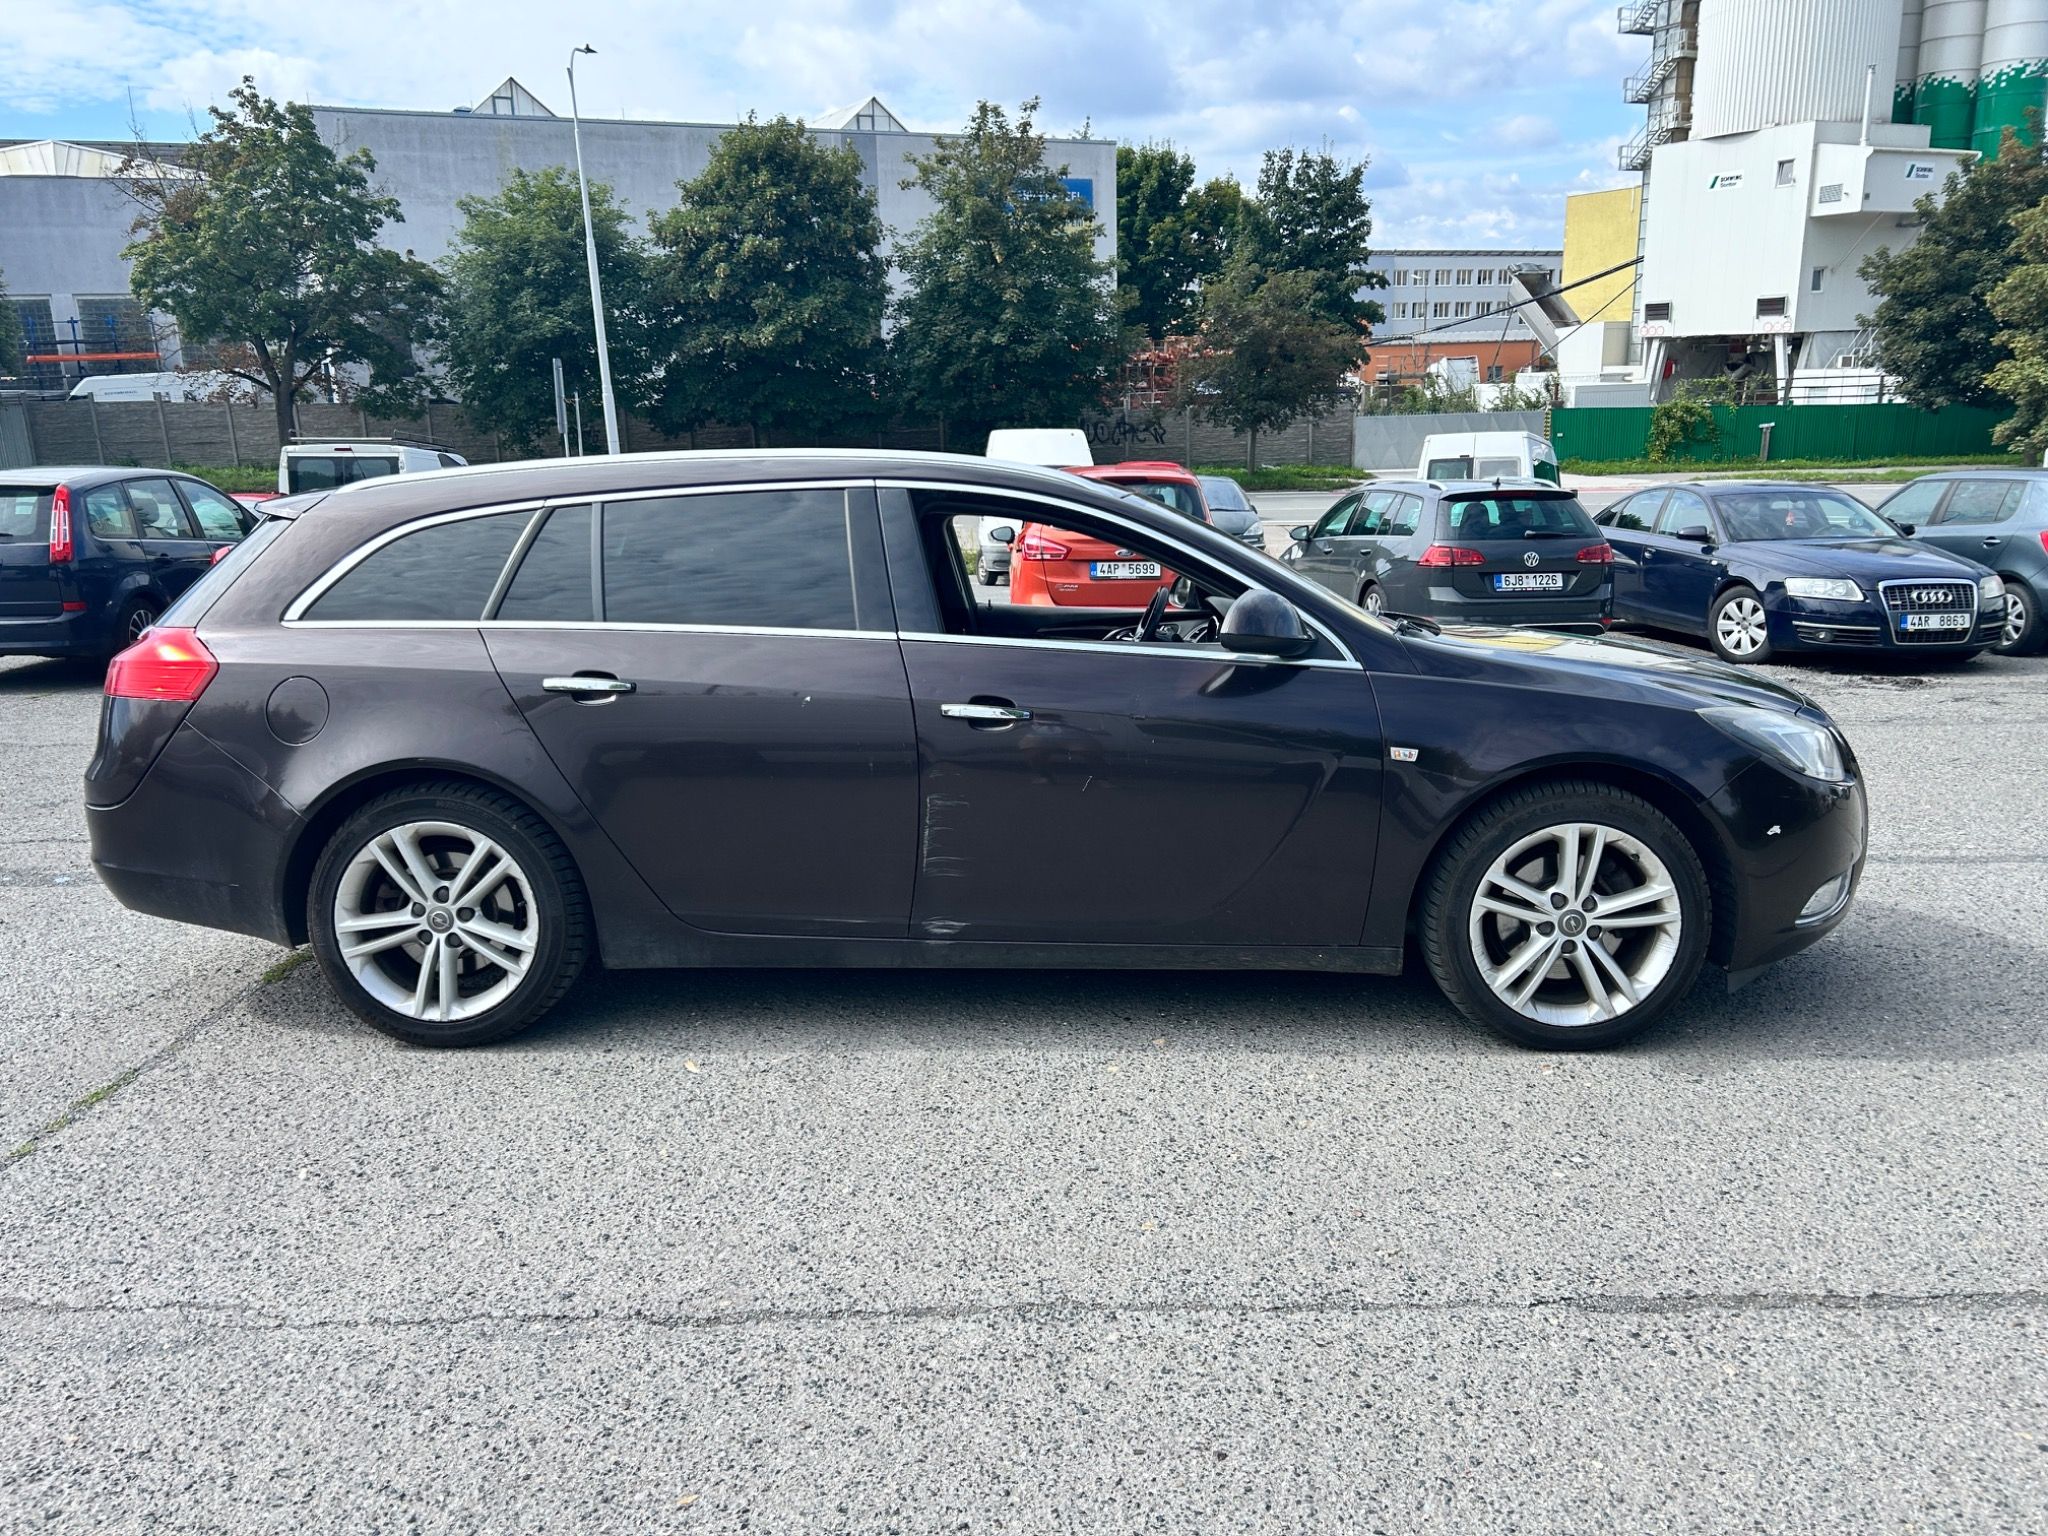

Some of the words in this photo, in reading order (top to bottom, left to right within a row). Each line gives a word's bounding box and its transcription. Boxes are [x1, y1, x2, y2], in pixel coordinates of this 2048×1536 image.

[1100, 563, 1120, 575] 4AP
[1128, 563, 1155, 575] 5699
[1504, 575, 1524, 587] 6J8
[1532, 574, 1558, 586] 1226
[1910, 616, 1930, 628] 4AR
[1939, 615, 1966, 627] 8863
